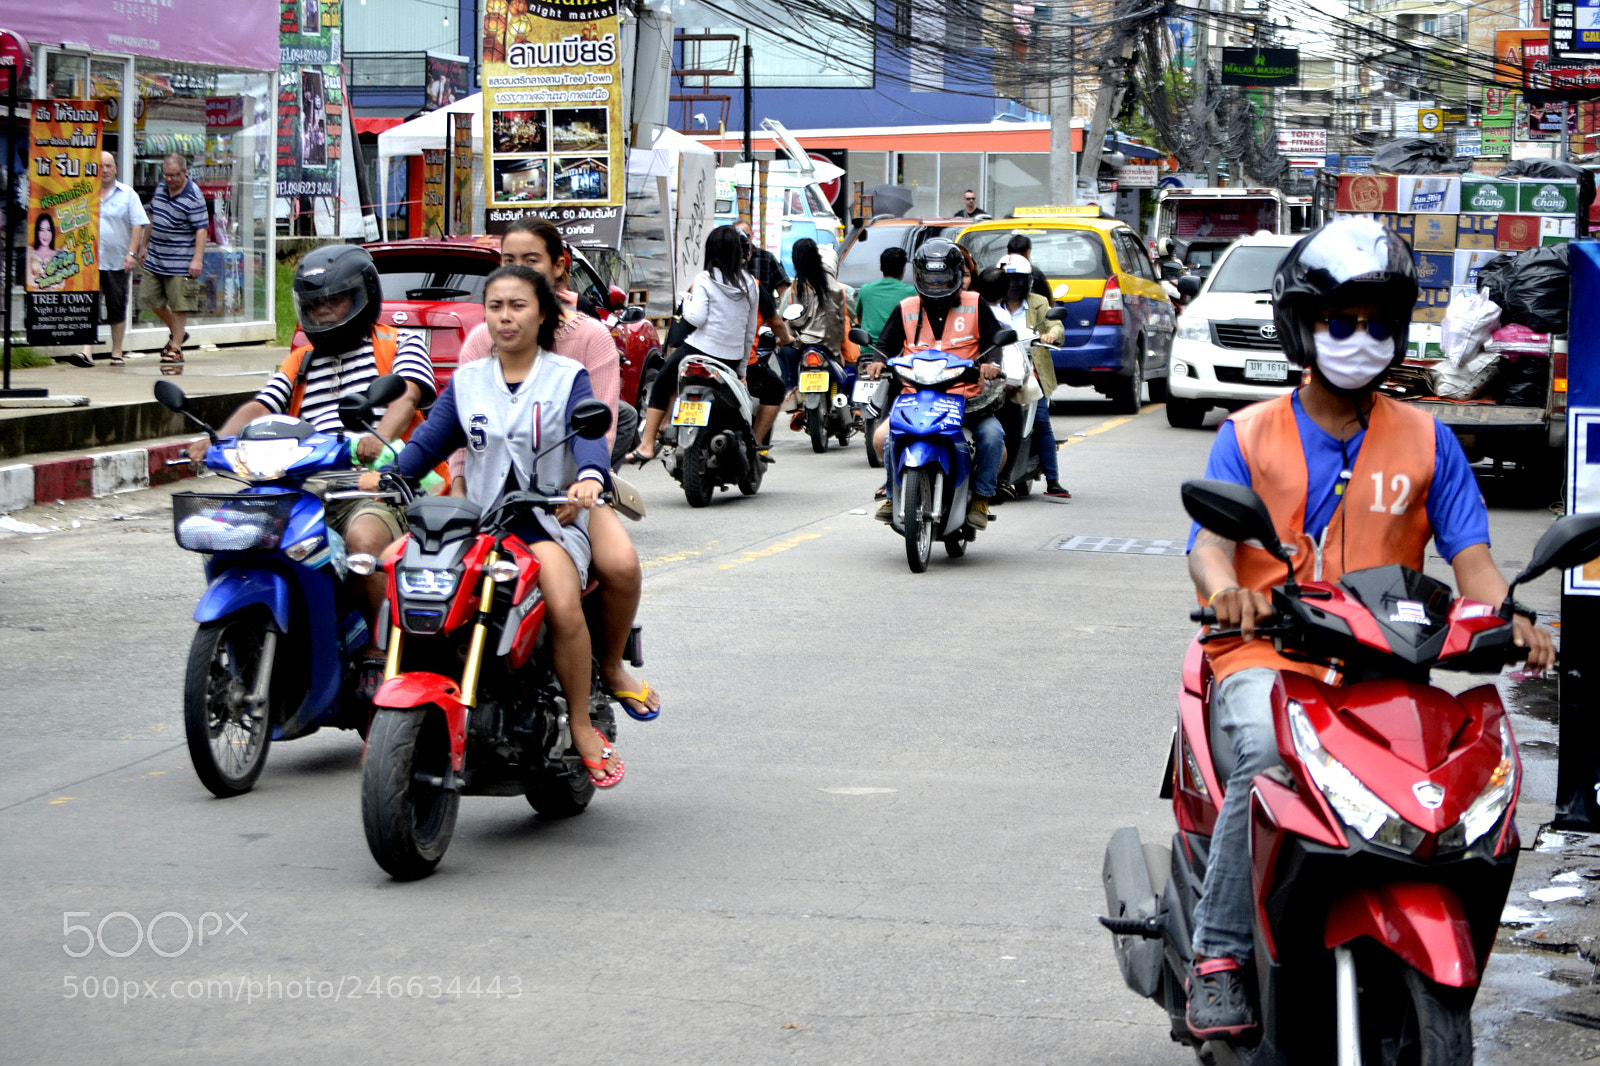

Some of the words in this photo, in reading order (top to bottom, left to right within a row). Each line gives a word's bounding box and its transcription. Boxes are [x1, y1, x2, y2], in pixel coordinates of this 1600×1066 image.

[529, 4, 562, 18] night
[568, 6, 614, 20] market
[507, 34, 617, 68] ลานเบียร์
[1224, 64, 1255, 73] MALAN
[488, 75, 562, 88] และดนตรีกลางลาน
[563, 76, 585, 85] Tree
[587, 74, 611, 83] Town
[85, 162, 97, 177] มา
[1353, 189, 1379, 202] LEO
[1472, 197, 1504, 209] Chang
[1533, 197, 1565, 209] Chang
[56, 198, 90, 233] 25
[562, 210, 576, 219] 60
[578, 207, 617, 219] เป็นต้นไป
[566, 224, 595, 235] อาทิตย์
[1415, 266, 1436, 277] iger
[31, 294, 59, 304] TREE
[61, 294, 93, 304] TOWN
[33, 306, 53, 315] Night
[954, 316, 966, 332] 6
[1267, 363, 1286, 371] 1614
[683, 417, 696, 425] 43
[469, 413, 489, 452] S
[1370, 471, 1412, 515] 12
